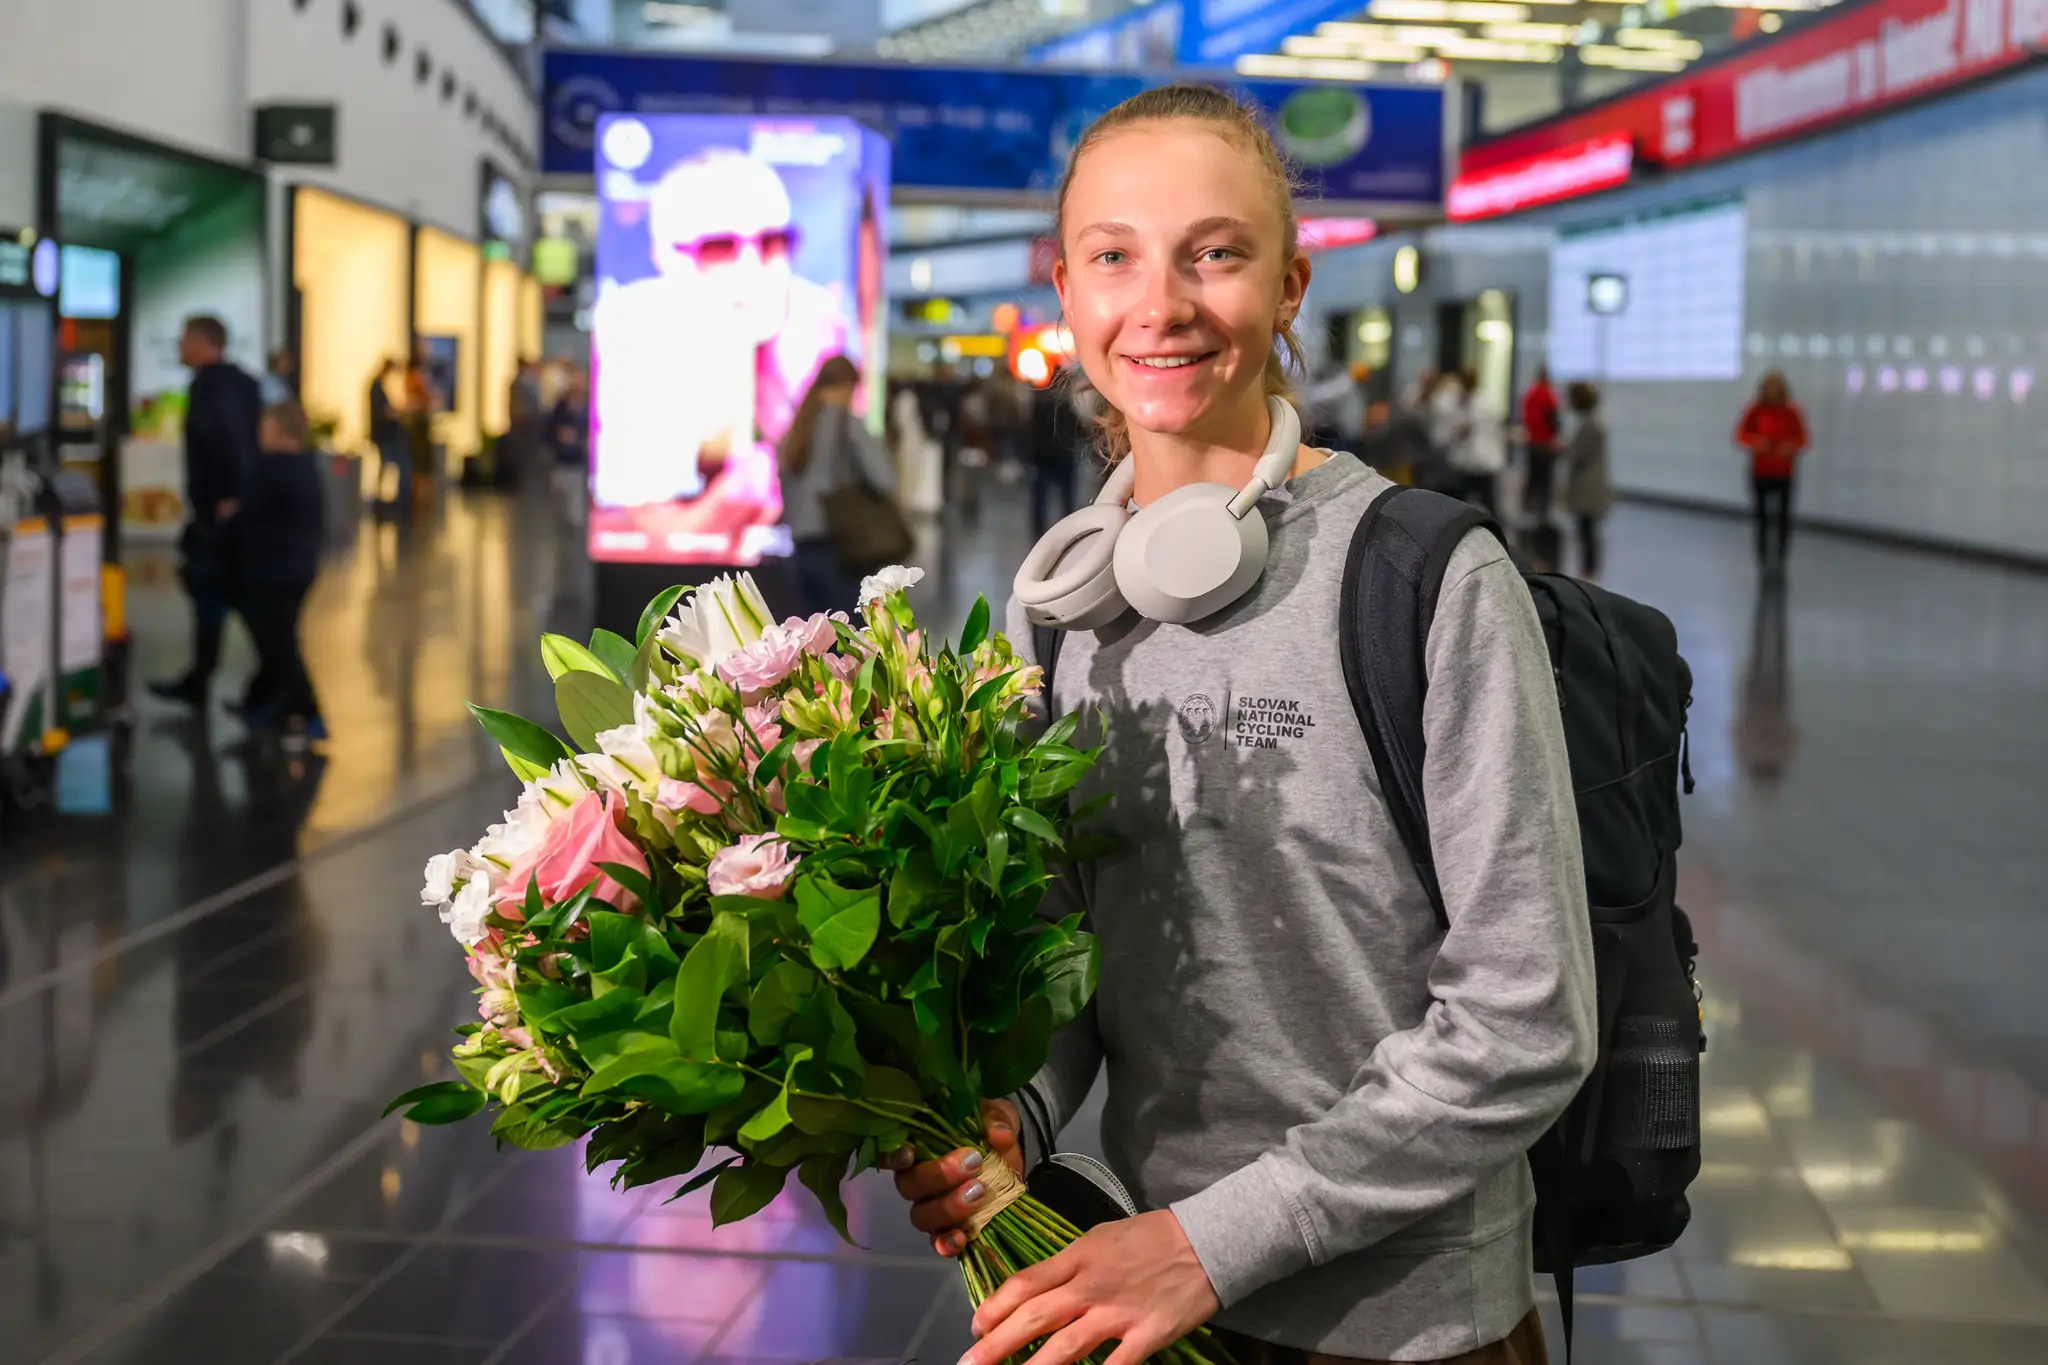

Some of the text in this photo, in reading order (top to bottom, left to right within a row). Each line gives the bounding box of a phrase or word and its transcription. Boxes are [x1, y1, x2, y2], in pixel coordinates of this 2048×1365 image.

[1239, 697, 1300, 713] SLOVAK
[1237, 710, 1316, 727] NATIONAL
[1236, 723, 1304, 738] CYCLING
[1235, 735, 1278, 749] TEAM
